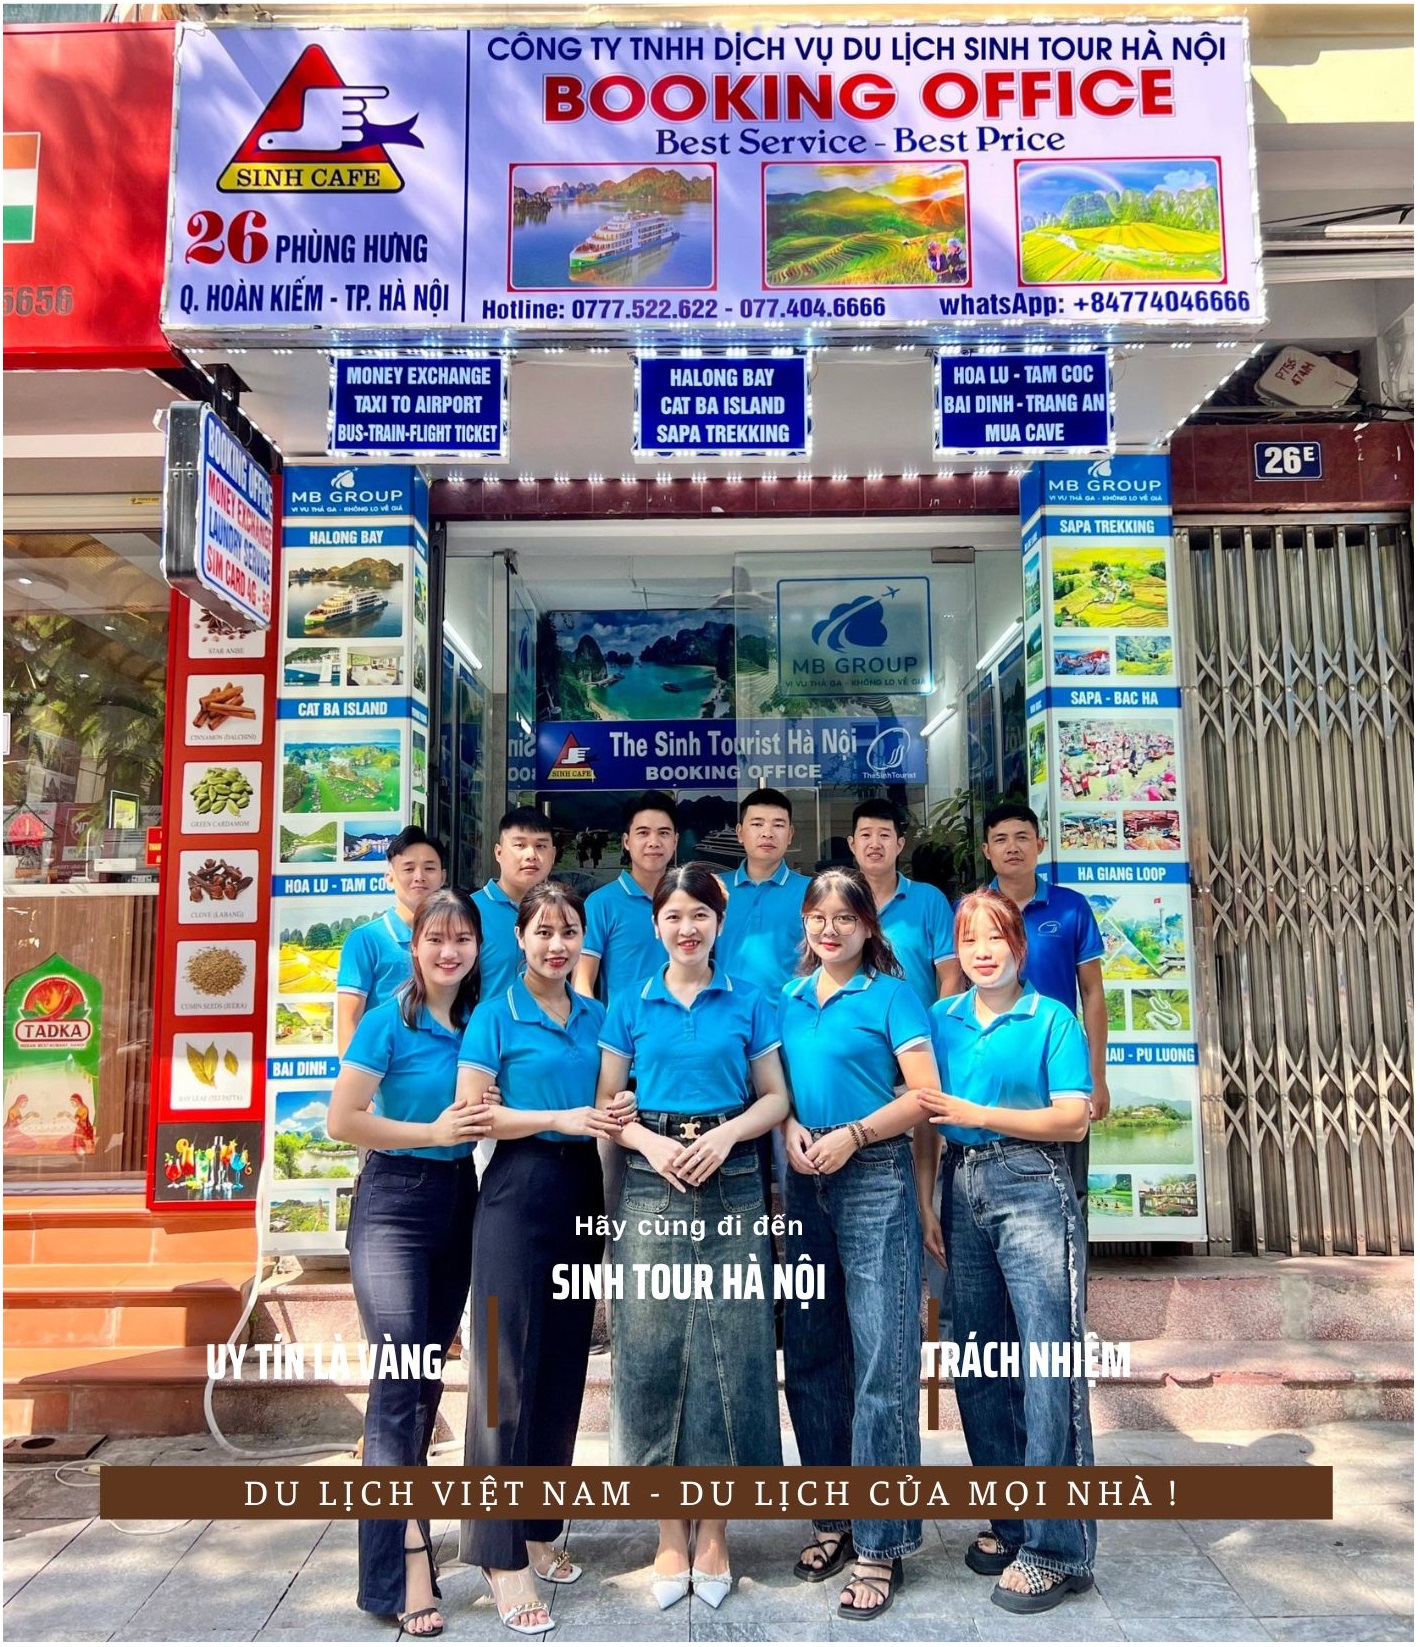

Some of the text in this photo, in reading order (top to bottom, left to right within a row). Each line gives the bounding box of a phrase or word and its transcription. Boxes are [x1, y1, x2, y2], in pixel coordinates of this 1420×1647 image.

[487, 28, 1225, 67] CÔNG TY TNHH DỊCH VỤ DU LỊCH SINH TOUR HÀ NỘI
[543, 66, 1176, 124] BOOKING OFFICE
[655, 125, 1065, 156] Best Service Best Price
[237, 168, 380, 187] SINH CAFE
[185, 209, 428, 265] 26 PHÙNG HƯNG
[3, 285, 74, 316] 5656
[180, 275, 450, 318] Q. HOÀN KIẾM TP. HÀ NỘI
[482, 290, 1250, 320] Hotline: 0777.522.622 077.404.6666 whatsApp: +84774046666
[346, 366, 491, 386] MONEY EXCHANGE
[670, 368, 775, 387] HALONG BAY
[953, 365, 1094, 385] HOA LU TAM COC
[354, 395, 483, 414] TAXI TO AIRPORT
[660, 396, 786, 415] CAT BA ISLAND
[944, 394, 1105, 414] BAI DINH TRANG AN
[337, 424, 498, 443] BUS-TRAIN-FLIGHT TICKET
[656, 424, 790, 443] SAPA TREKKING
[985, 423, 1065, 442] MUA CAVE
[208, 418, 272, 517] BOOKING OFFICE
[1048, 480, 1161, 491] MB GROUP
[291, 490, 403, 503] MB GROUP
[208, 469, 272, 554] MONEY EXCHANGE
[1060, 520, 1154, 533] SAPA TREKKING
[209, 506, 270, 586] LAUNDRY SERVICE
[310, 530, 384, 545] HALONG BAY
[207, 544, 223, 581] SIM
[225, 560, 246, 597] CARD
[247, 577, 257, 606] 4G
[793, 657, 918, 674] MB GROUP
[1071, 691, 1158, 705] SAPA BAC HA
[298, 701, 388, 717] CAT BA ISLAND
[609, 728, 857, 761] The Sinh Tourist Hà Nội
[646, 764, 821, 780] BOOKING OFFICE
[1078, 867, 1166, 881] HA GIANG LOOP
[284, 879, 310, 893] HOA
[313, 879, 328, 893] LU
[340, 878, 366, 892] TAM
[24, 1024, 82, 1038] TADKA
[1136, 1048, 1152, 1062] PU
[1156, 1048, 1195, 1062] LUONG
[273, 1061, 327, 1077] BAI DINH
